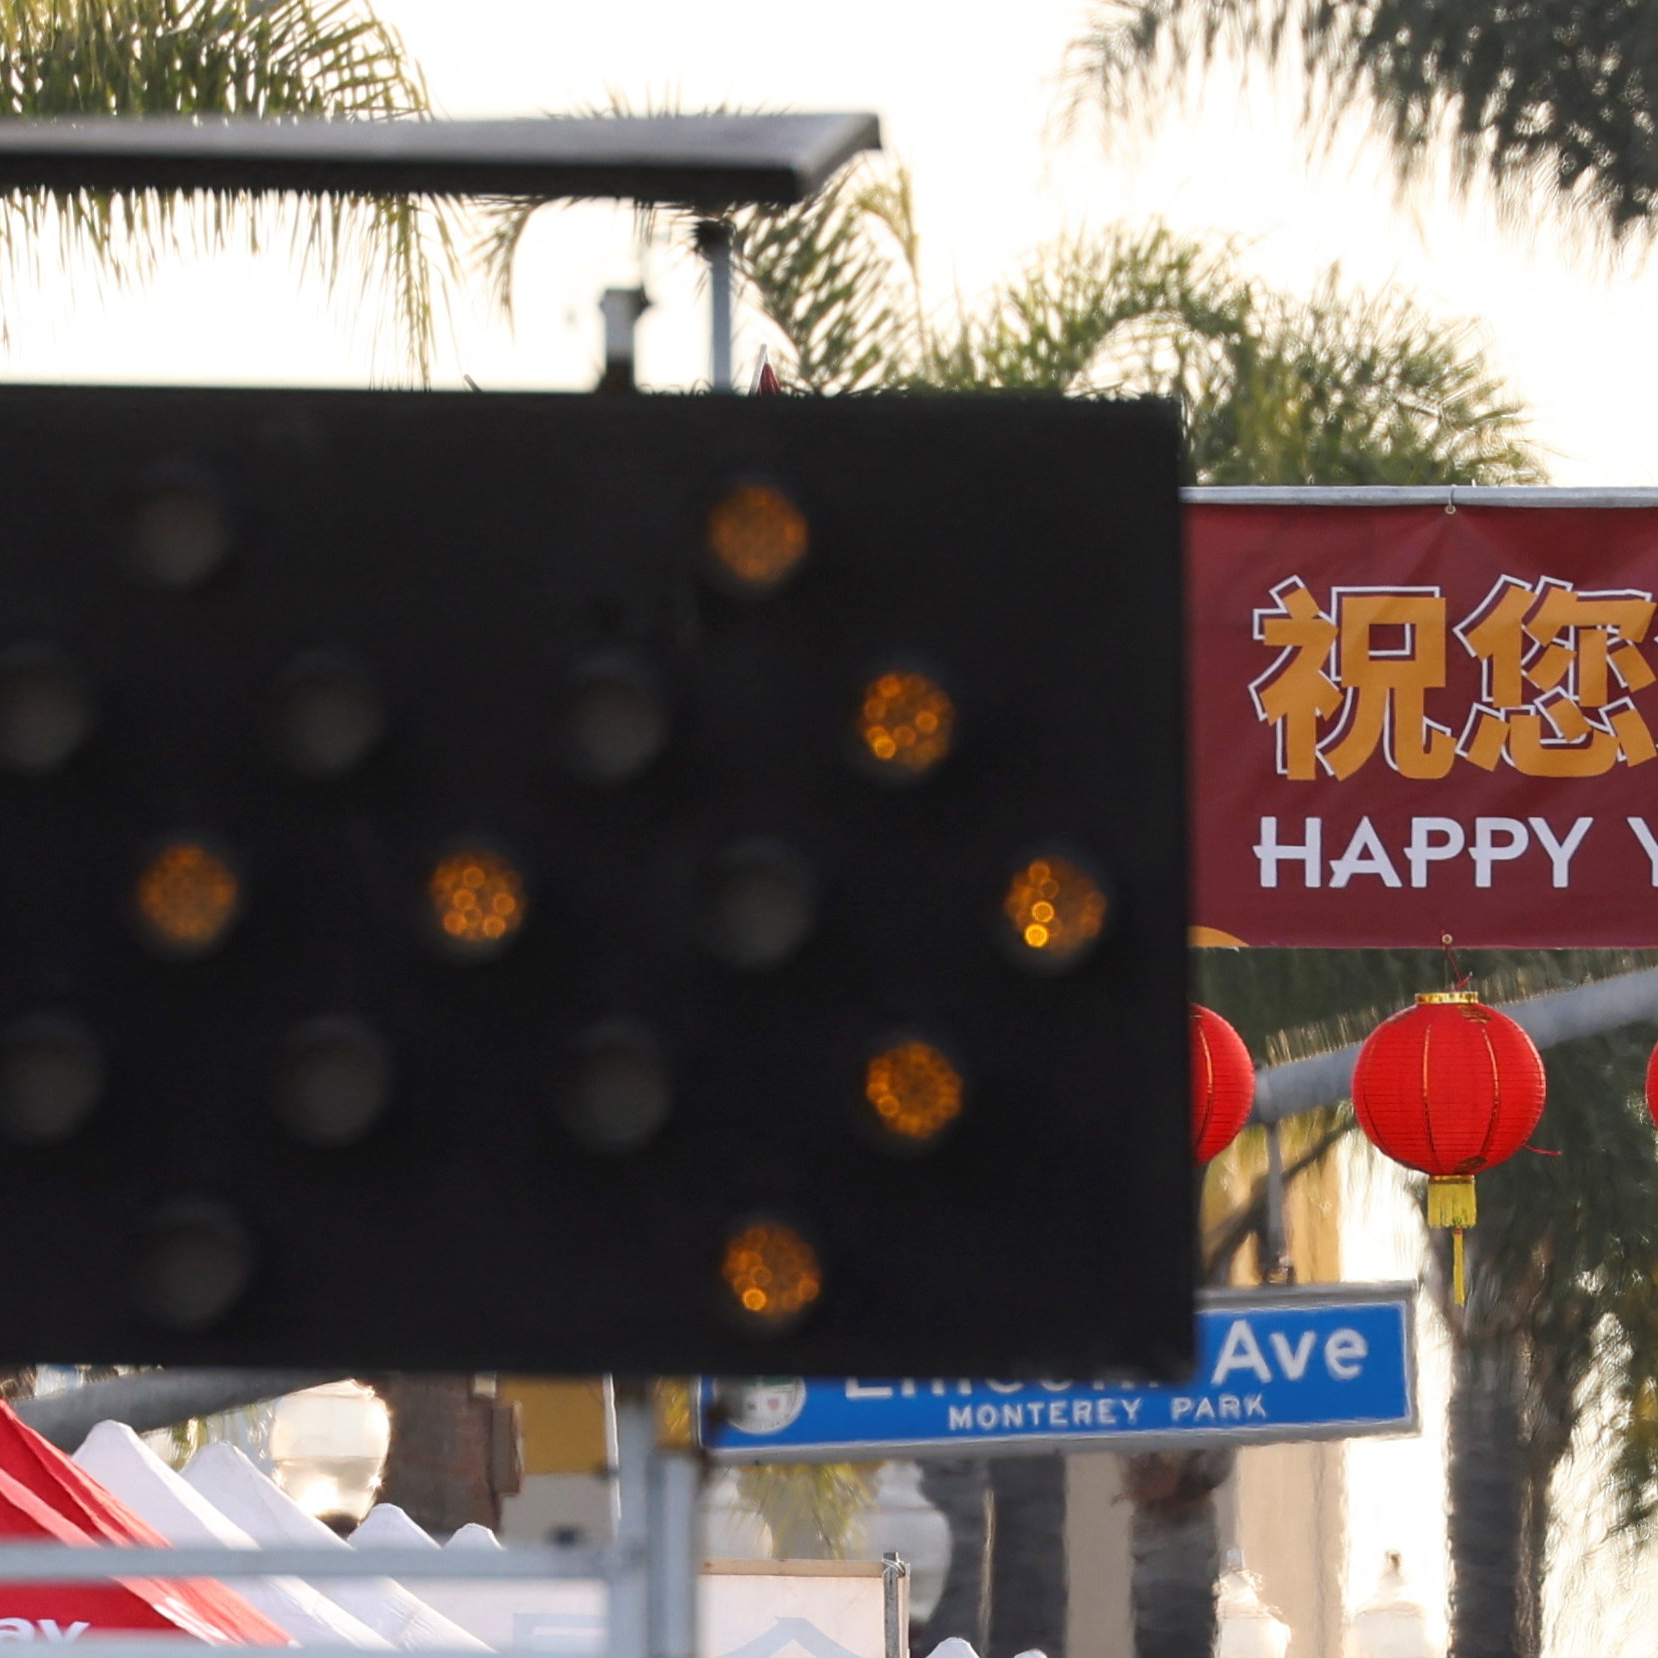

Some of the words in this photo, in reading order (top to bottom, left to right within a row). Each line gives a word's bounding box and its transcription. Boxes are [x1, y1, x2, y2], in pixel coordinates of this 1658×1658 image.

[1252, 816, 1594, 888] HAPPY
[1211, 1318, 1370, 1386] Ave
[948, 1398, 1145, 1432] MONTEREY
[1170, 1393, 1267, 1420] PARK
